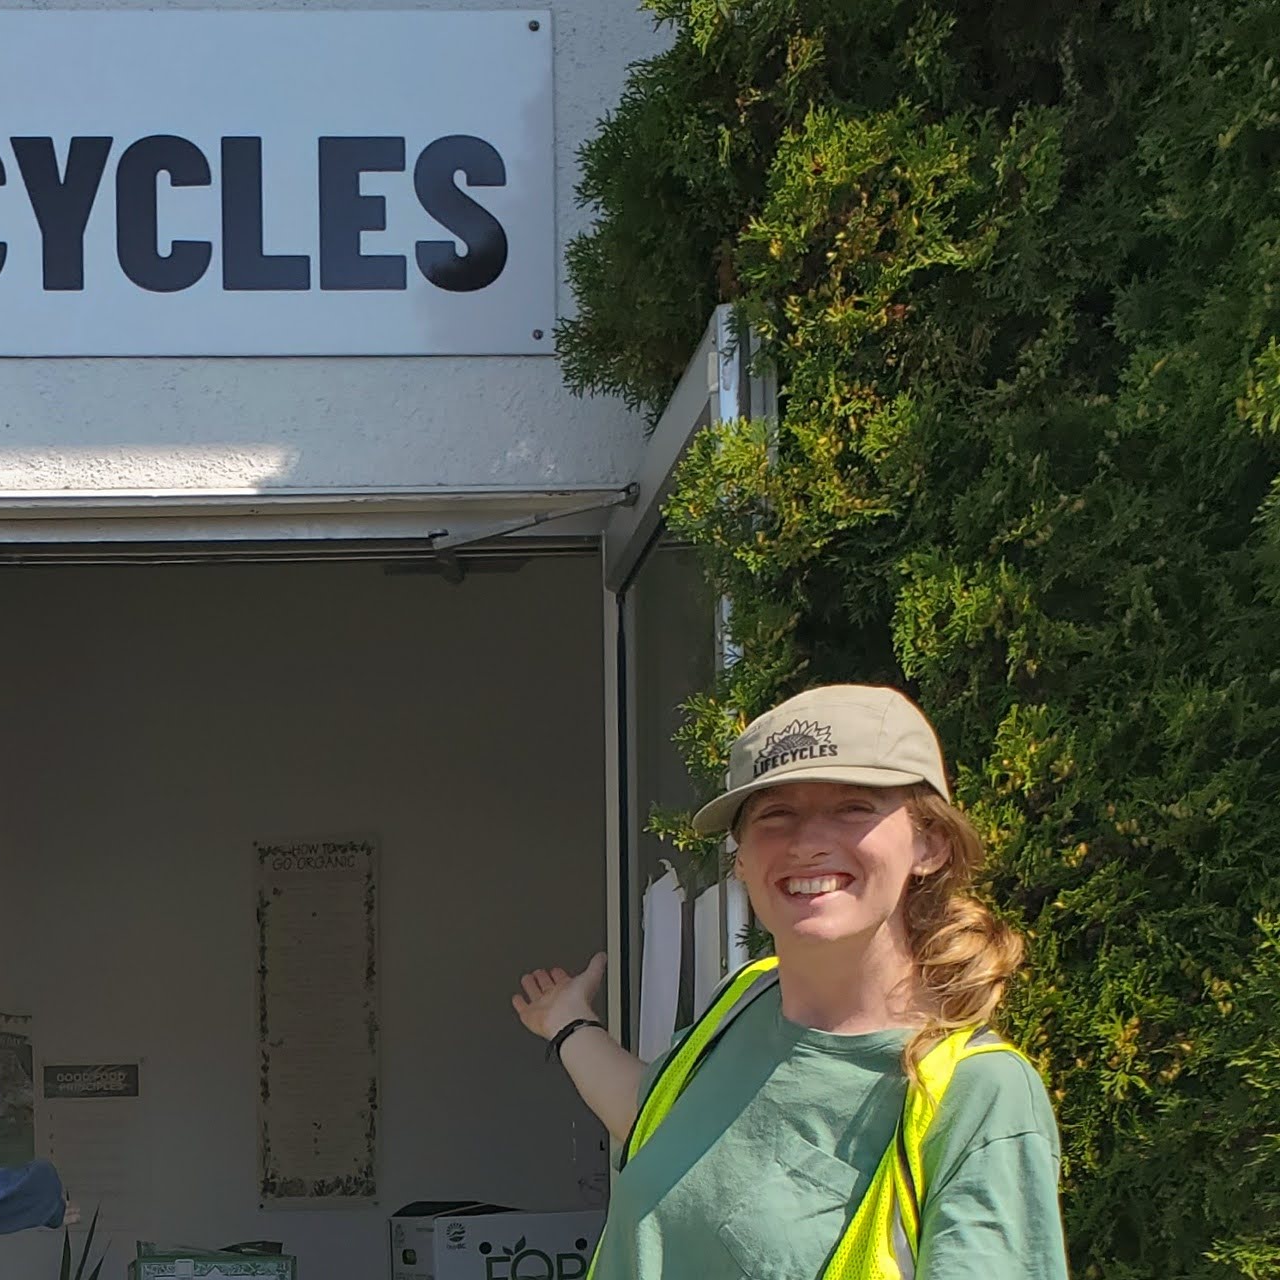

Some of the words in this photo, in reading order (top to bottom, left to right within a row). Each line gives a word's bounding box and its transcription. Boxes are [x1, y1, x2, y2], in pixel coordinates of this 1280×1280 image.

[752, 744, 838, 778] LIFECYCLES
[272, 856, 292, 871] GO
[297, 854, 356, 870] ORGANIC
